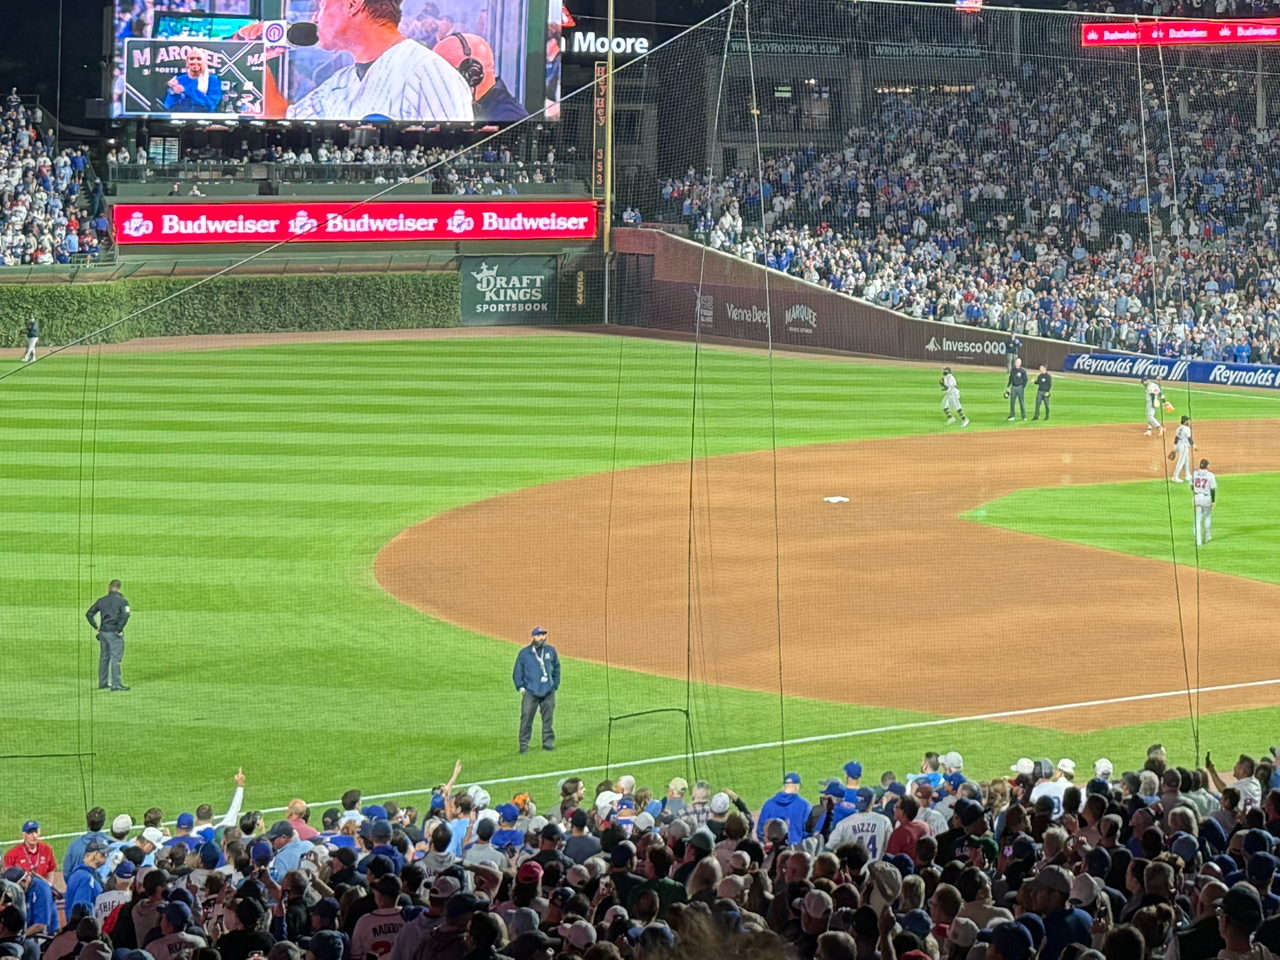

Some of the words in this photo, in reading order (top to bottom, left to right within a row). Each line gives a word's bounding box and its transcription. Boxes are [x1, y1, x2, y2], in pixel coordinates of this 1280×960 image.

[573, 31, 649, 53] Moore
[596, 98, 606, 126] Hey
[161, 214, 280, 234] Budweiser
[325, 213, 438, 233] Budweiser
[482, 212, 589, 231] Budweiser
[476, 274, 545, 292] DRAFT
[577, 271, 585, 305] 353
[484, 288, 543, 301] KINGS
[475, 302, 548, 314] SPORTSBOOK
[726, 302, 752, 322] Vienna
[785, 304, 818, 328] MARQUEE
[943, 337, 983, 353] Invesco
[984, 340, 1007, 355] QQQ
[1073, 353, 1131, 374] Reynolds
[1132, 358, 1168, 378] Wrap
[1209, 364, 1274, 386] Reynolds
[852, 822, 877, 835] RIZZO
